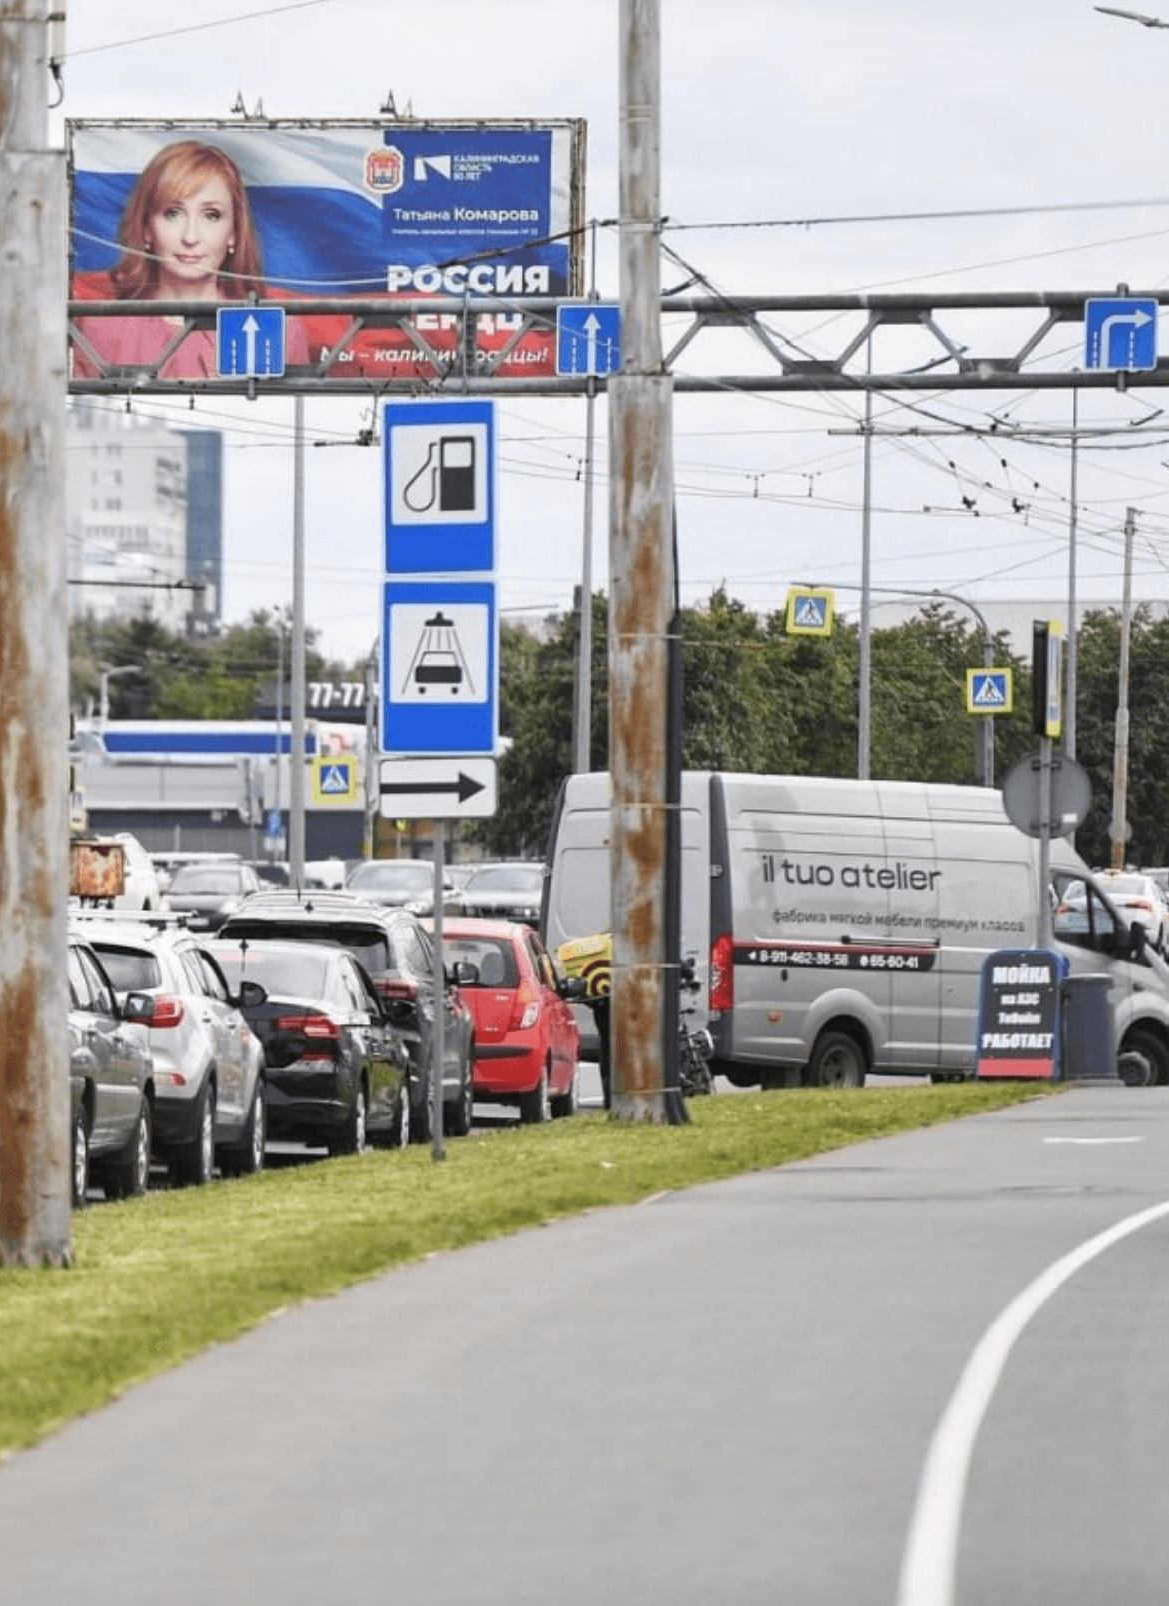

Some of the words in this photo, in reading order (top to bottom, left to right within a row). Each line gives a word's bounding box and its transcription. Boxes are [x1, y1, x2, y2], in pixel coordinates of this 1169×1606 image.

[393, 208, 451, 221] Татьяна
[454, 206, 539, 224] Комарова
[387, 264, 550, 294] РОССИЯ
[762, 855, 775, 883] il
[781, 859, 834, 887] tuo
[840, 862, 942, 891] atelier
[773, 908, 826, 924] фабрика
[830, 912, 872, 925] мягкой
[875, 914, 922, 928] мебели
[925, 917, 978, 933] премиум
[981, 921, 1025, 932] класса
[992, 963, 1051, 984] МОЙКА
[982, 1032, 1054, 1049] РАБОТАЕТ
